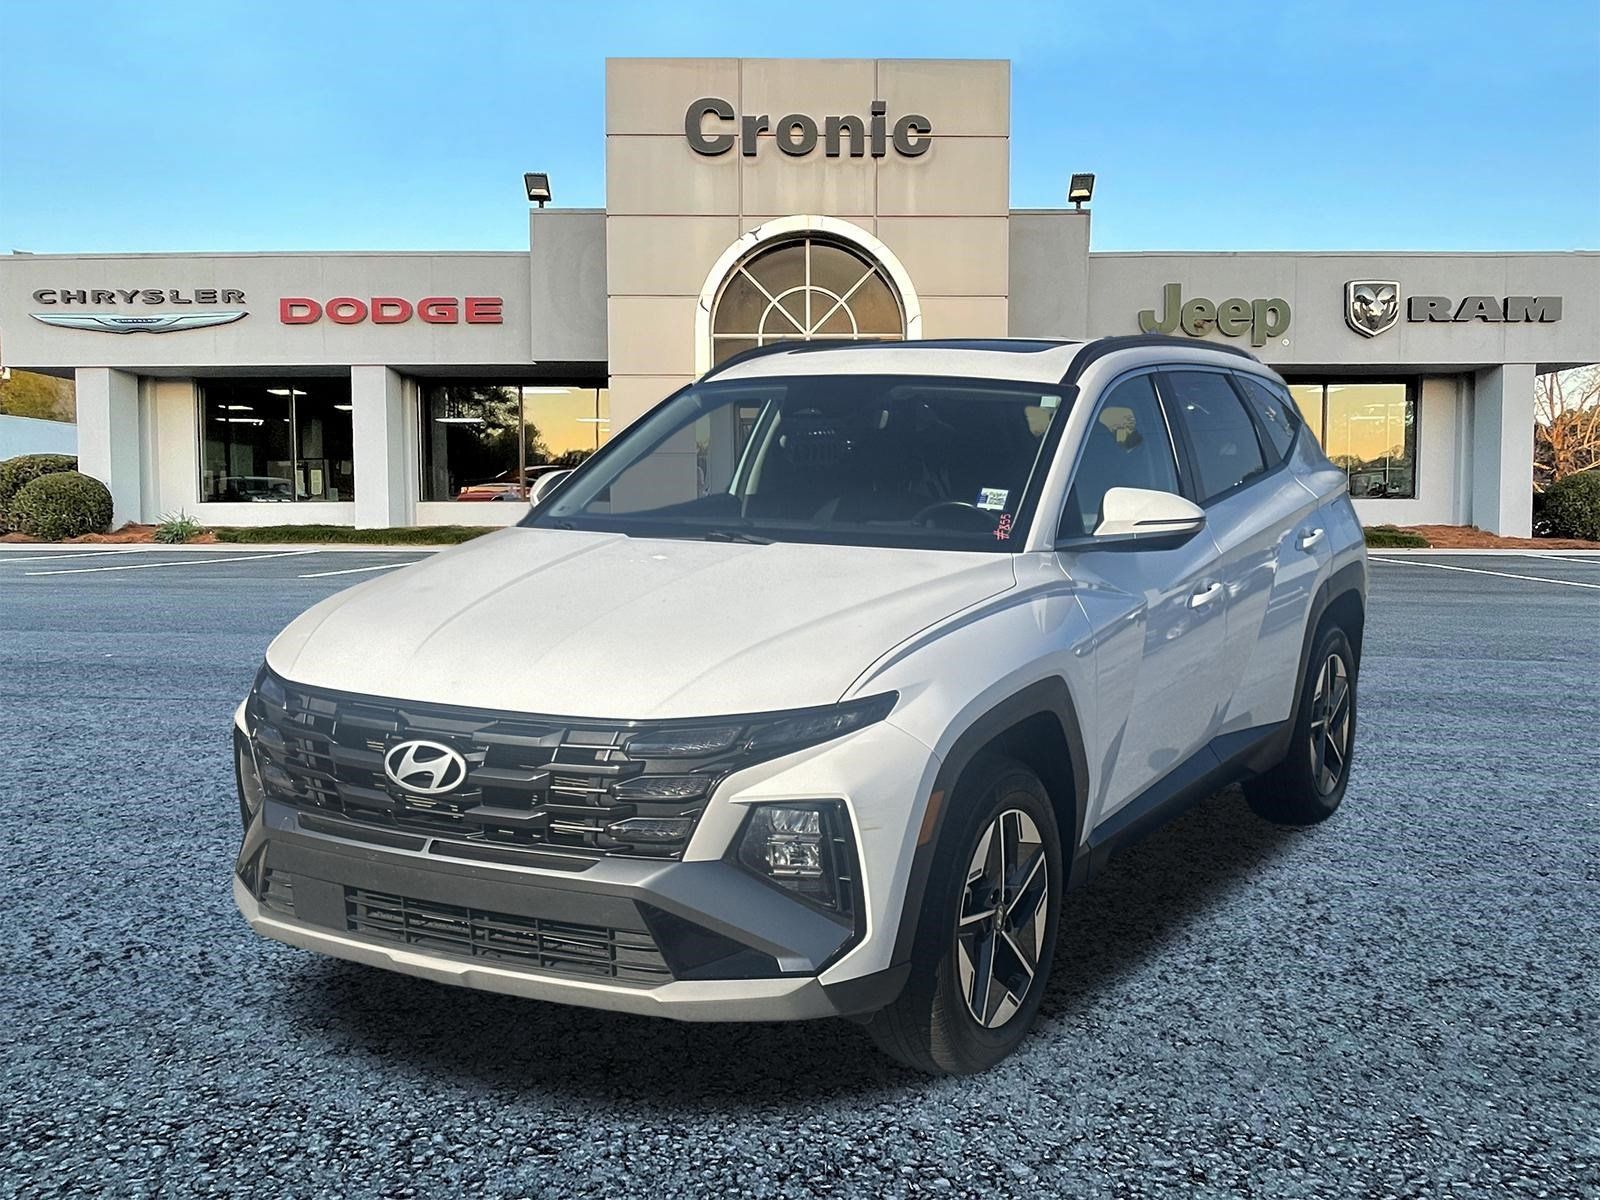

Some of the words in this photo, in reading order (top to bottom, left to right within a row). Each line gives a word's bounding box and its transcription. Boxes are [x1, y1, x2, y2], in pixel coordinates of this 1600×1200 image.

[685, 97, 932, 157] Cronic
[32, 289, 247, 304] CHRYSLER
[1407, 296, 1562, 322] RAM
[280, 297, 503, 324] DODGE
[1138, 283, 1291, 347] Jeep
[993, 513, 1011, 540] #855
